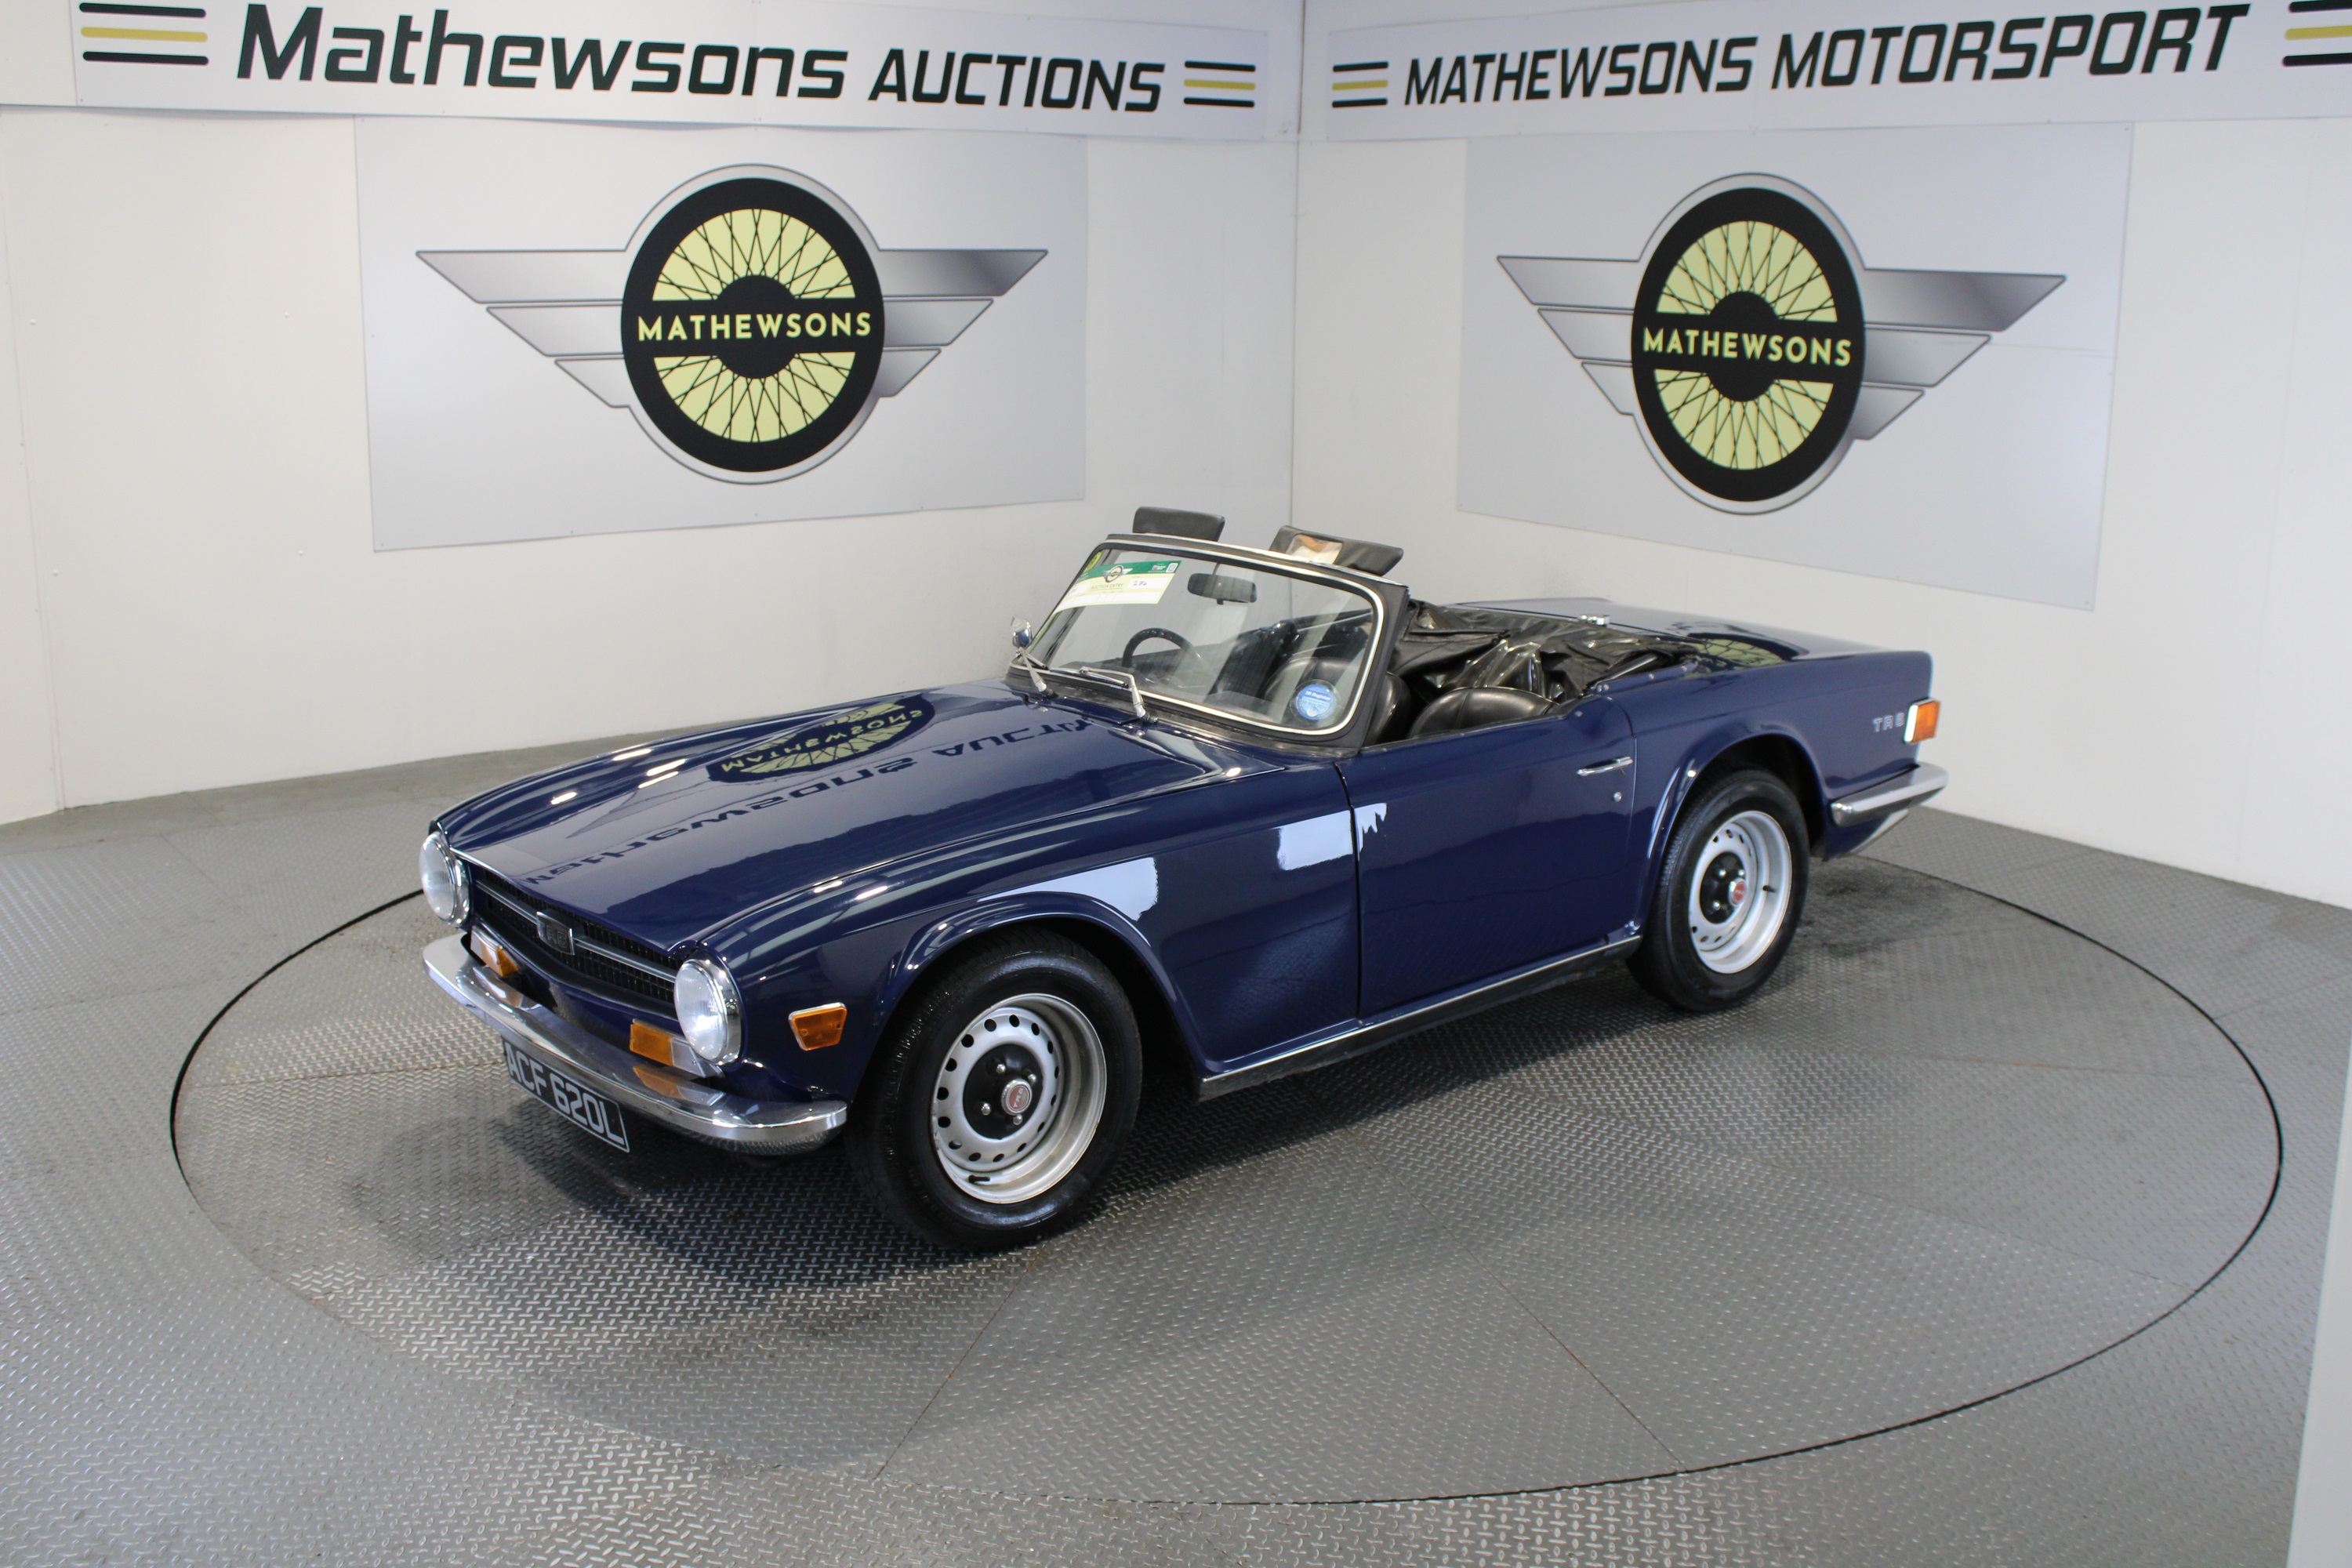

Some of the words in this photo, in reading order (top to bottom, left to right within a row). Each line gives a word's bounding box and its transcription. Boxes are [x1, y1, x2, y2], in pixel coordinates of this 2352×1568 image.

[238, 4, 848, 98] Mathewsons
[869, 49, 1164, 112] AUCTIONS
[1405, 37, 1757, 105] MATHEWSONS
[1772, 4, 2250, 89] MOTORSPORT
[637, 311, 871, 341] MATHEWSONS
[1642, 326, 1852, 367] MATHEWSONS
[1871, 712, 1905, 732] TR6
[537, 920, 568, 949] TR6
[505, 1041, 547, 1097] ACF
[549, 1073, 625, 1146] 620L
